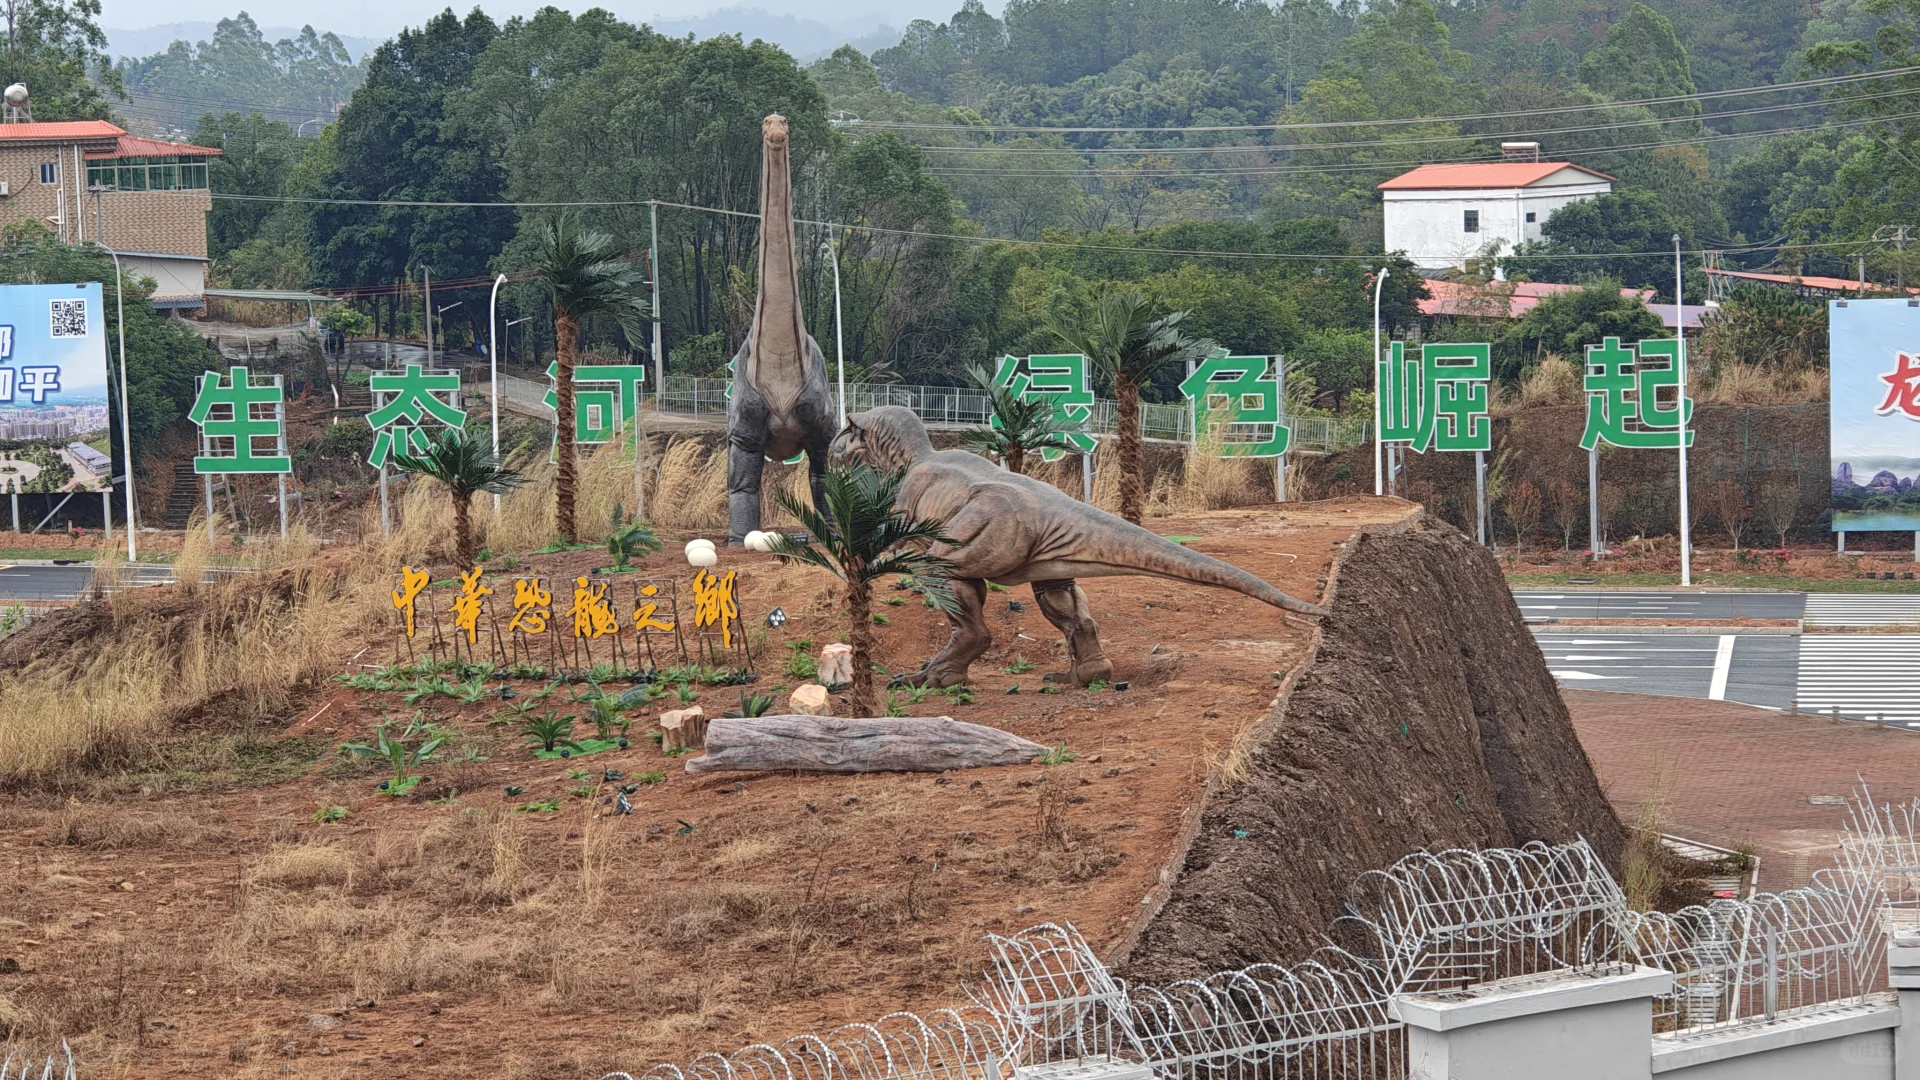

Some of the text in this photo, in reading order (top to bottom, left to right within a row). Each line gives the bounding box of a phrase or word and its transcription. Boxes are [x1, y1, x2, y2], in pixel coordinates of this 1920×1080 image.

[187, 336, 1695, 475] 生态河 绿色崛起
